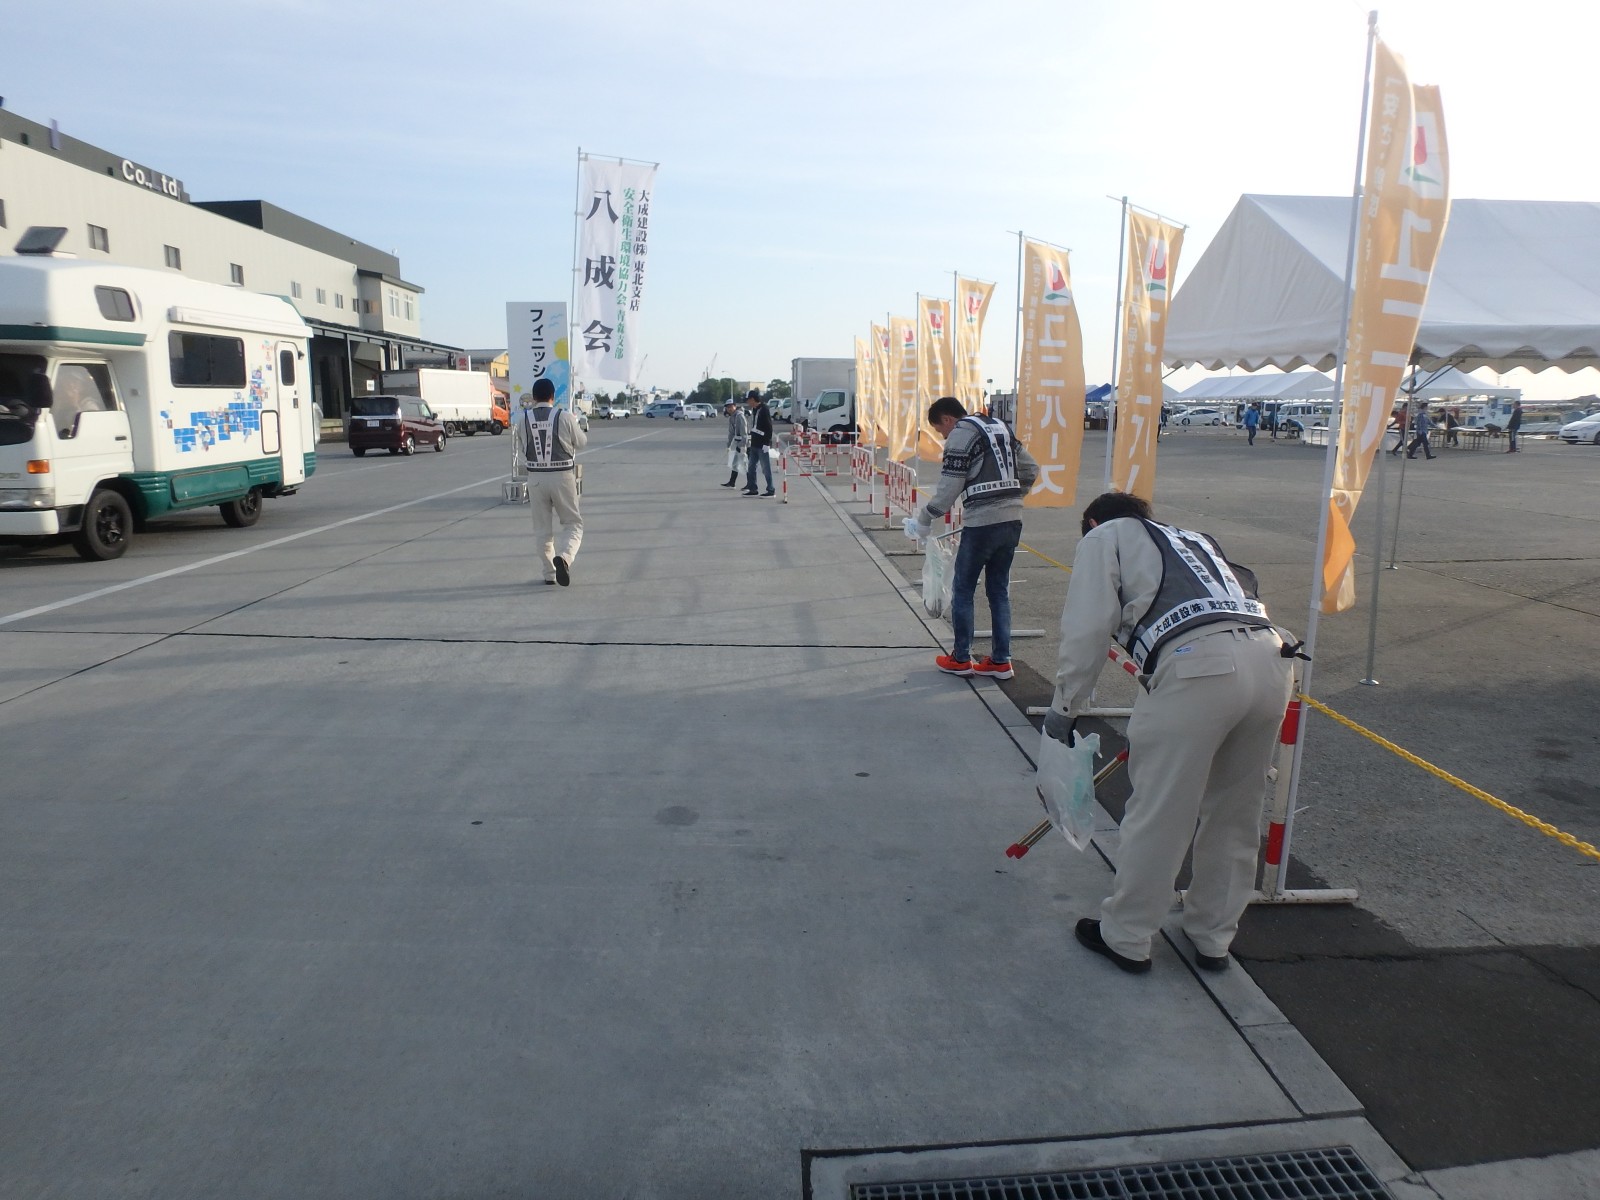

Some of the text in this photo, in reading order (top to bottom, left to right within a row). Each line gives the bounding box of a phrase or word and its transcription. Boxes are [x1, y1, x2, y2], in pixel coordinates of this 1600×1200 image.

[582, 189, 619, 353] 八成会
[614, 186, 636, 360] 安全衛生環境協力会 青森支部
[629, 188, 651, 312] 大成建設(株) 東北支店
[1154, 600, 1262, 637] 大成建設(株) 東北支店 安全
